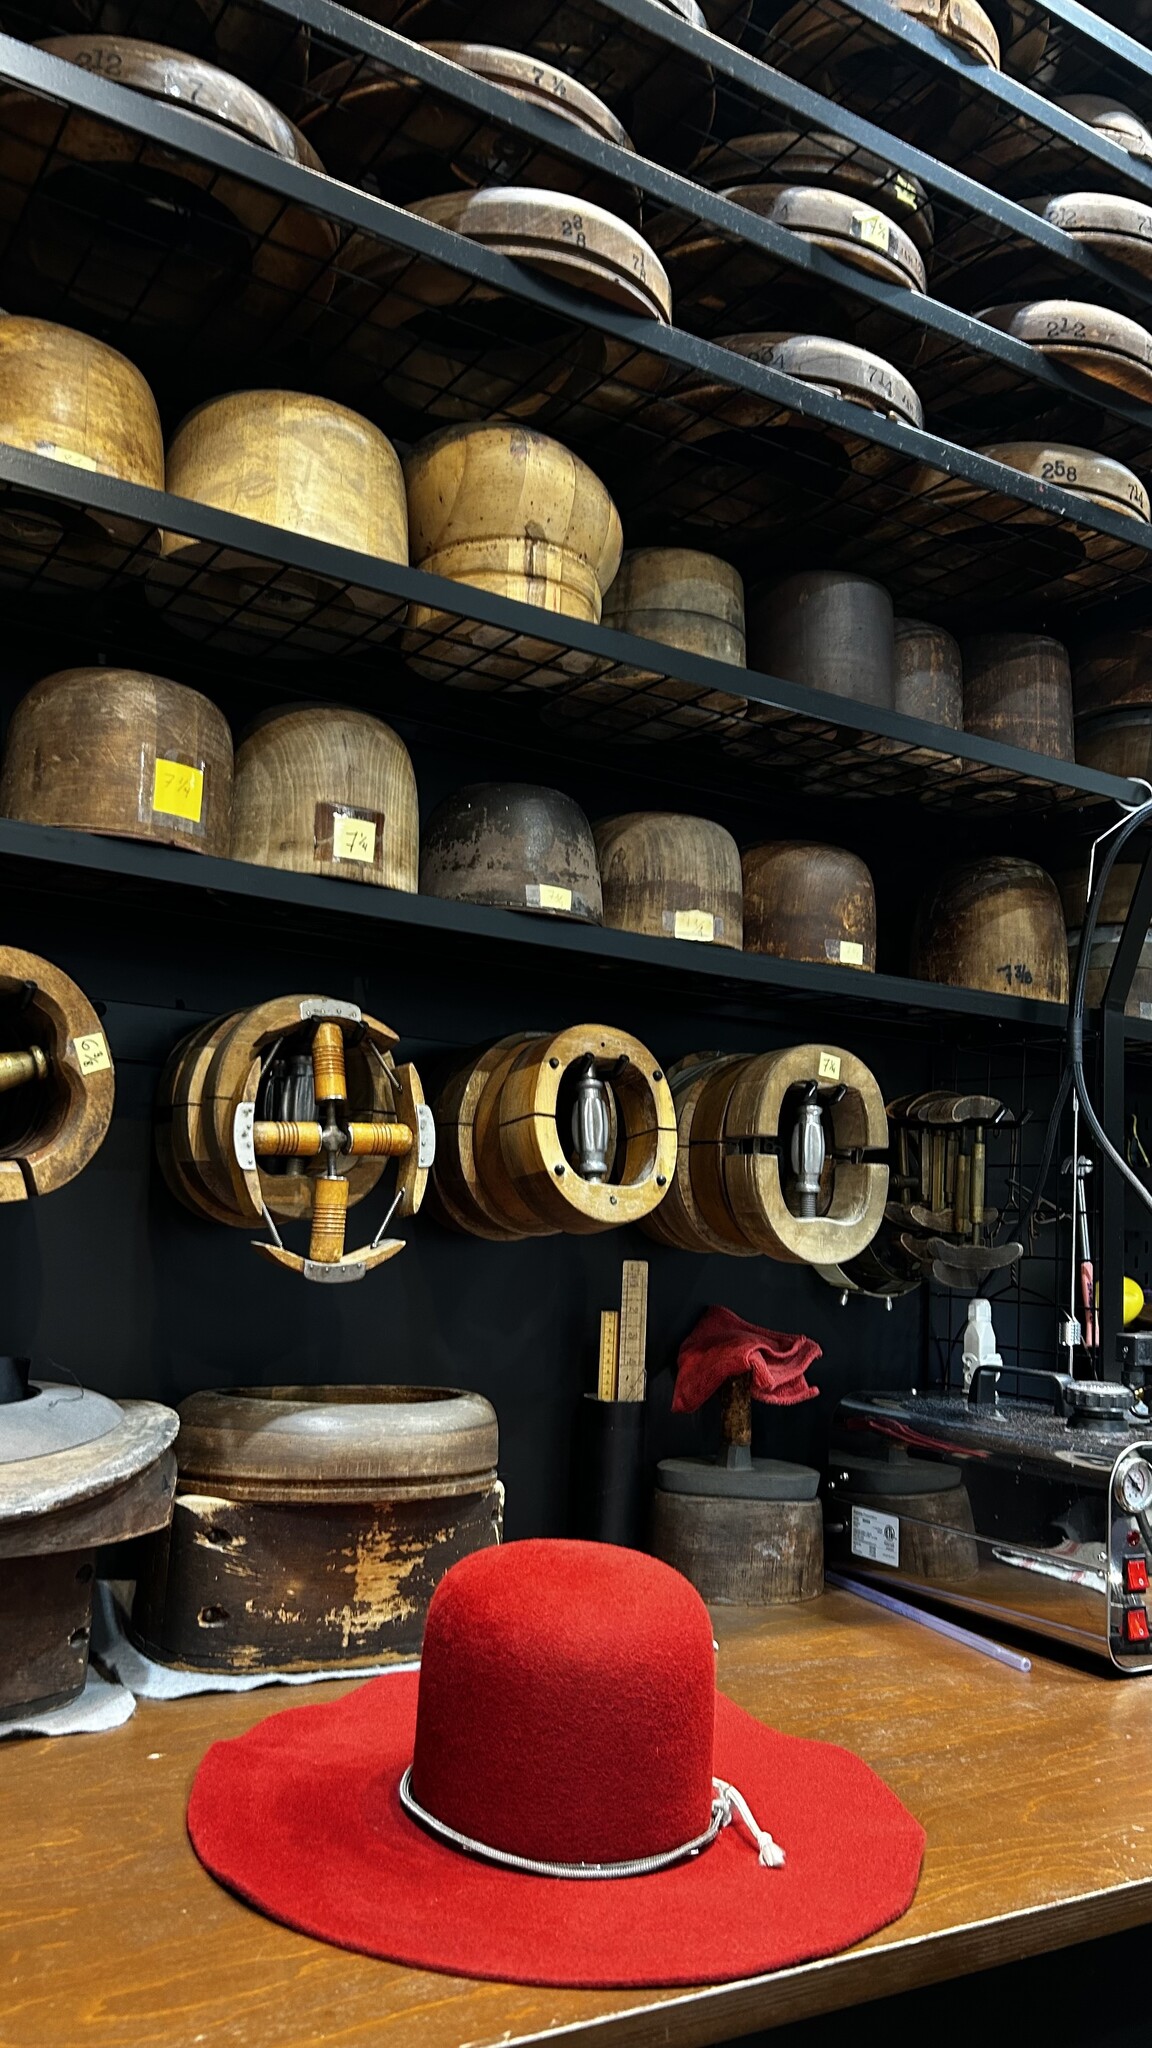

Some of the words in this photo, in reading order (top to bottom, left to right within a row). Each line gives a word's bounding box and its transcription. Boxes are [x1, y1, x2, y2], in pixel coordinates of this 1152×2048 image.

[1041, 461, 1077, 482] 258
[345, 831, 358, 853] 7
[997, 964, 1012, 986] 7
